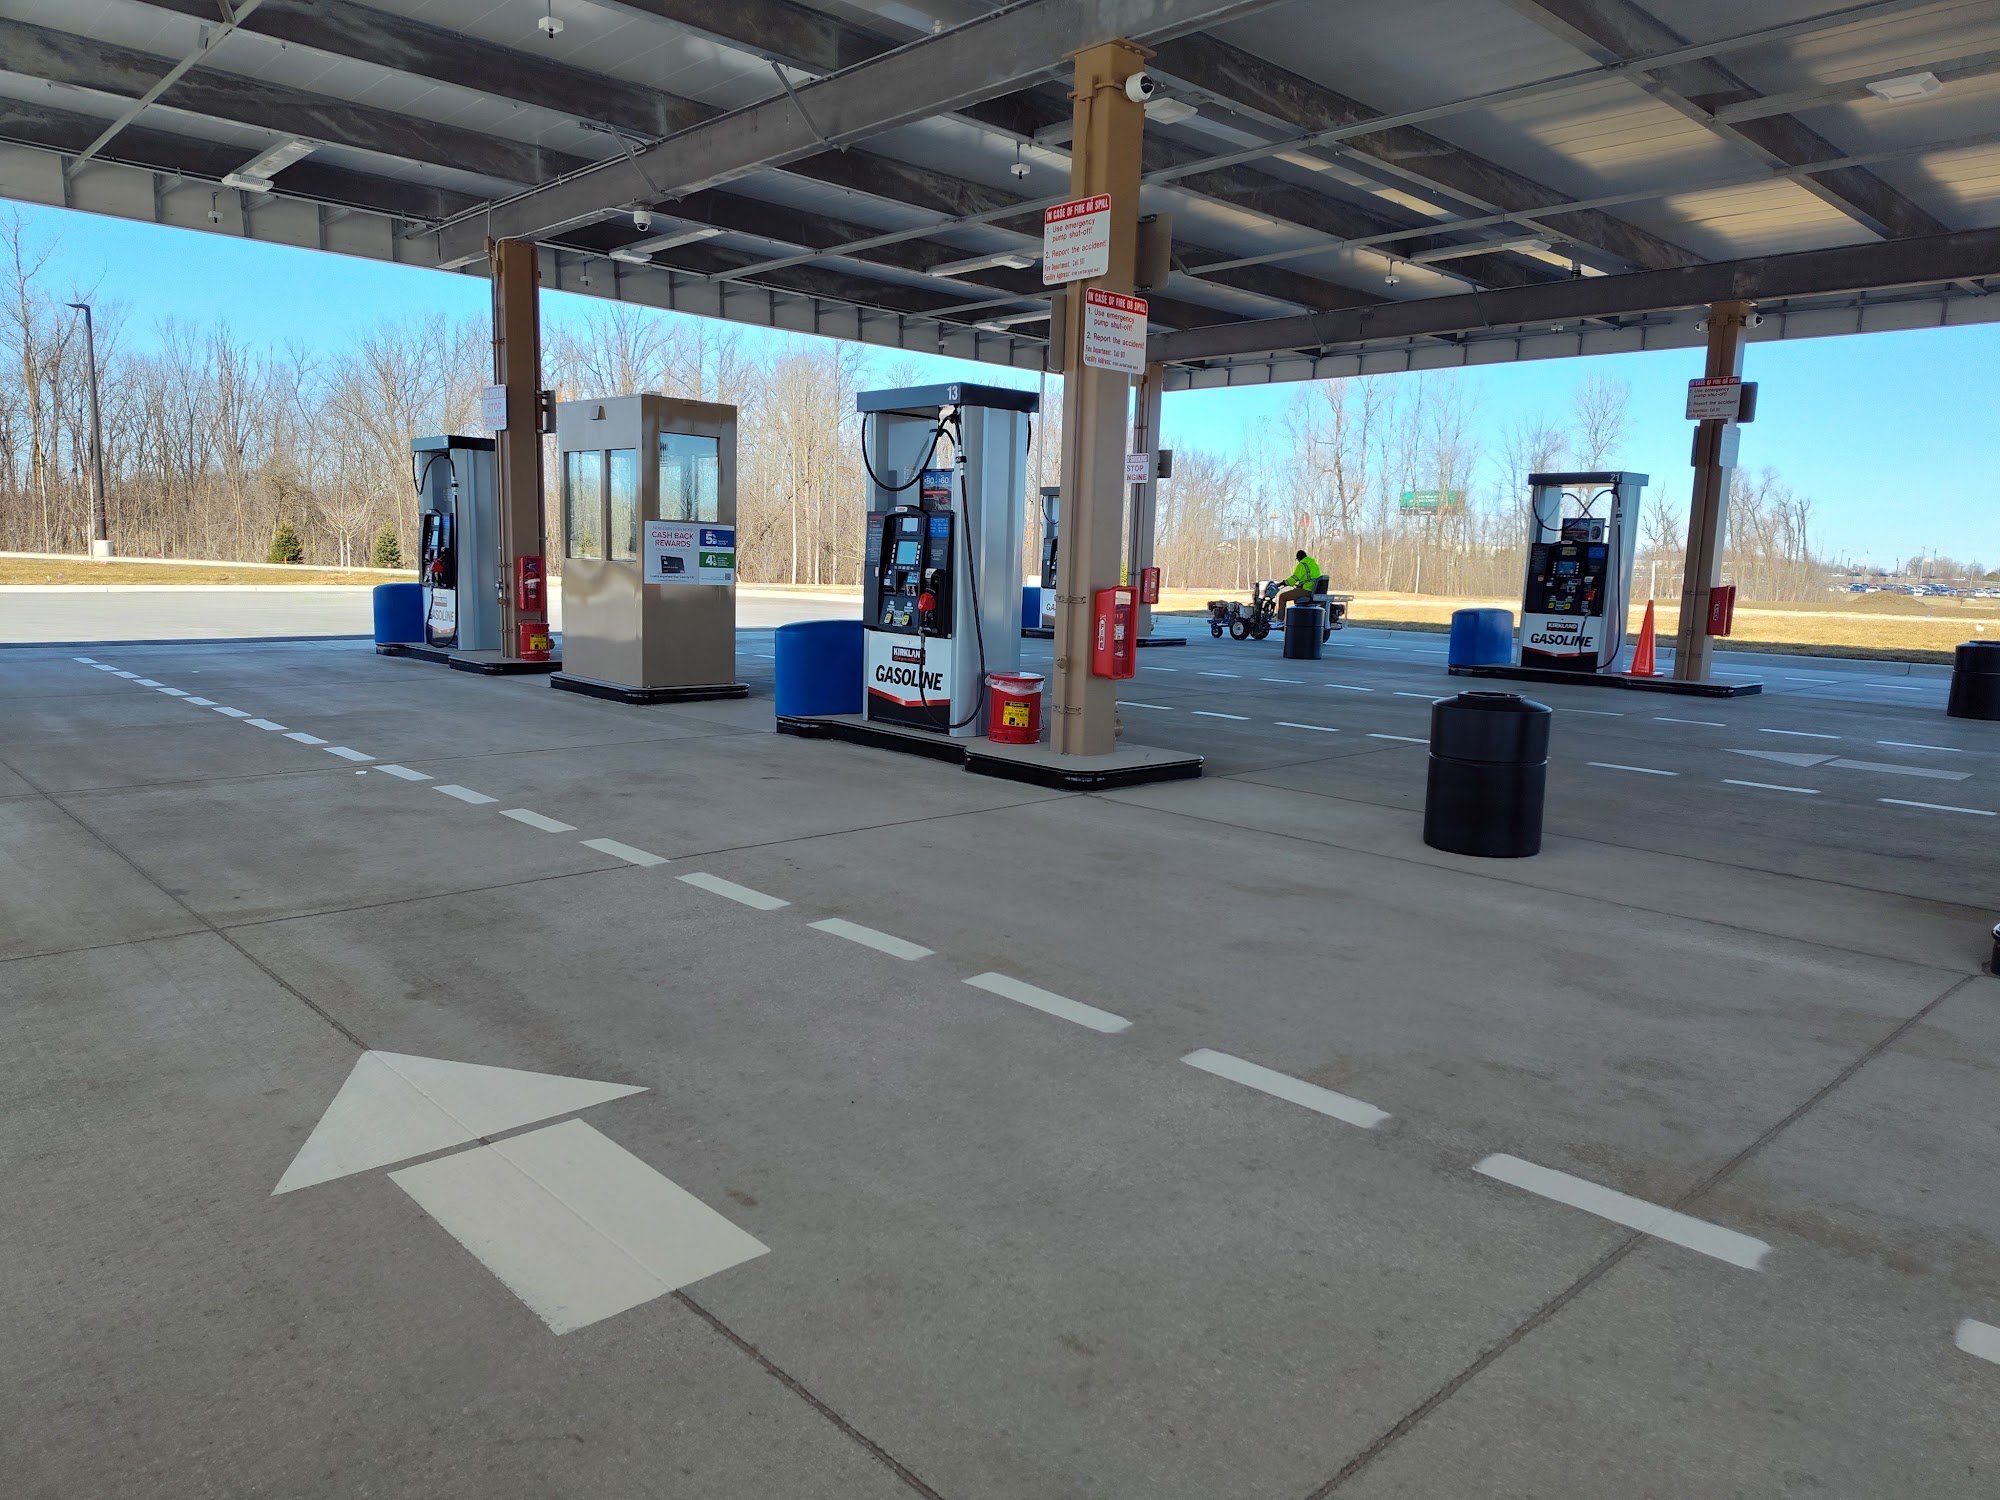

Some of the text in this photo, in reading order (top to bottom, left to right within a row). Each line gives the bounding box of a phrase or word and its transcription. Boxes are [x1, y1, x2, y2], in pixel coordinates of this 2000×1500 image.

[1047, 198, 1108, 221] IN CASE OF FIRE OR SPILL
[1053, 224, 1063, 233] Use
[1065, 218, 1095, 229] emergency
[1052, 227, 1092, 243] pump shut-off!
[1052, 248, 1069, 258] Report
[1082, 240, 1107, 251] accident!
[1088, 292, 1146, 313] IN CASE OF FIRE OR SPILL
[1094, 308, 1104, 316] Use
[1107, 311, 1134, 324] emergency
[1094, 319, 1132, 331] pump shut-off!
[1094, 333, 1110, 342] Report
[1122, 340, 1144, 349] accident!
[947, 385, 958, 401] 13
[488, 402, 502, 413] STOP
[485, 415, 505, 426] ENGINE
[1126, 464, 1144, 472] STOP
[1610, 473, 1620, 482] 21
[651, 531, 694, 540] CASH BACK
[655, 539, 691, 548] REWARDS
[431, 609, 454, 622] ASOLINE
[1530, 633, 1593, 648] GASOLINE
[893, 647, 922, 659] KIRKLAN
